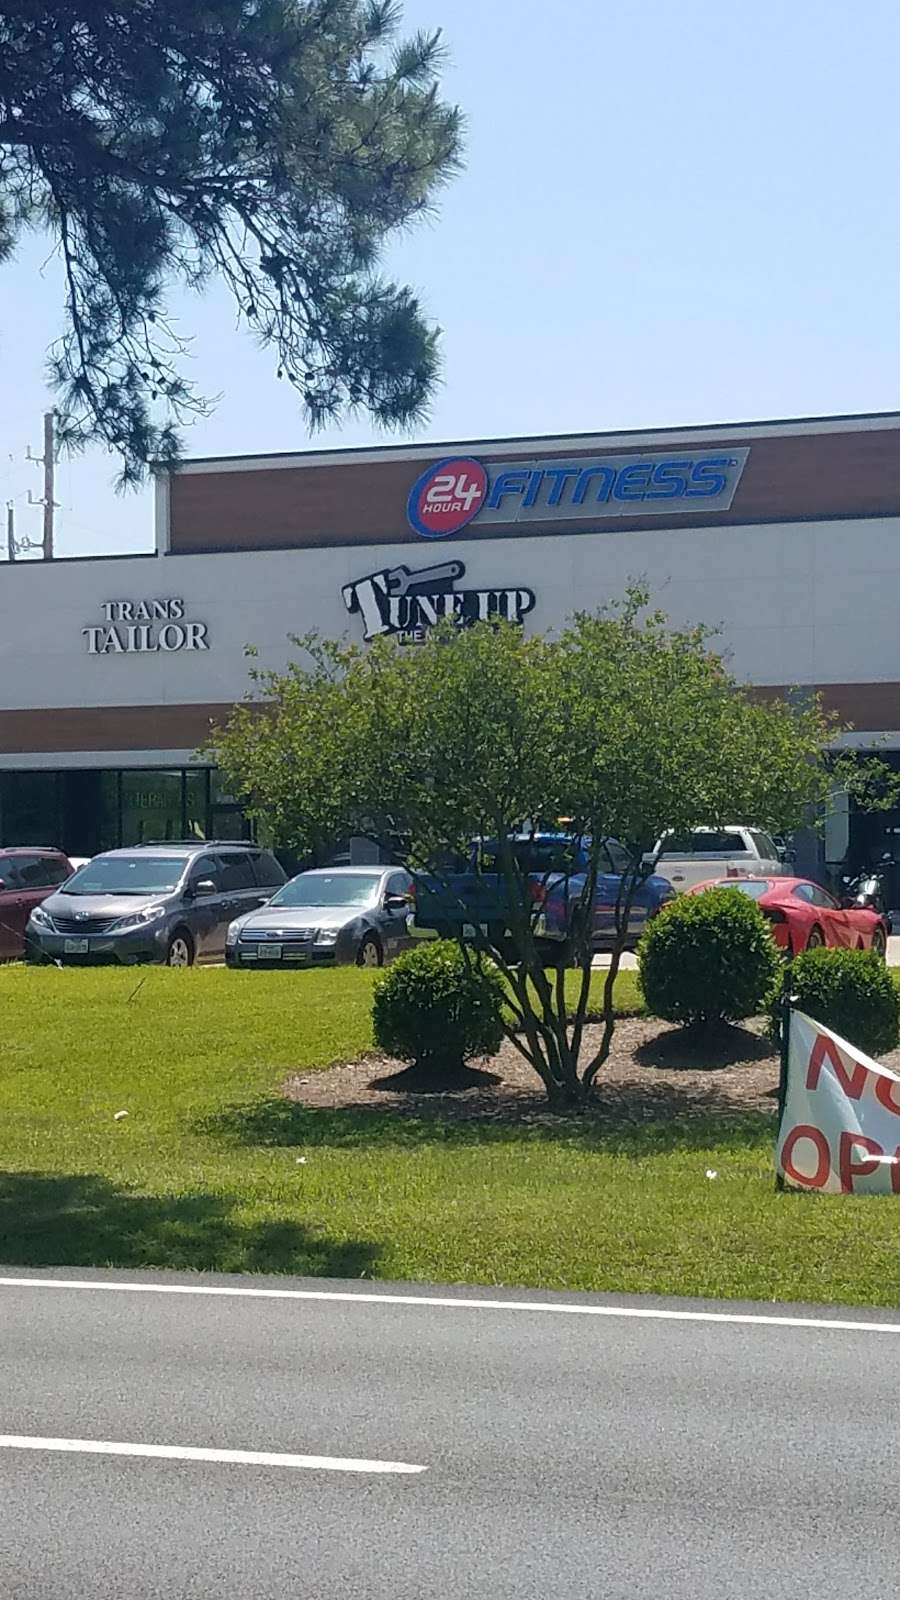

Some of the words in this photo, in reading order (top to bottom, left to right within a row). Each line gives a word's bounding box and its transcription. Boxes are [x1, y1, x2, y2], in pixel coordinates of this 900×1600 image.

[427, 474, 481, 510] 24
[486, 458, 729, 509] FITNESS
[423, 502, 462, 513] HOUR
[101, 599, 183, 621] TRANS
[342, 574, 464, 639] TUNE
[477, 591, 530, 622] UP
[81, 623, 209, 654] TAILOR
[396, 630, 425, 643] THE
[780, 1124, 900, 1194] OP
